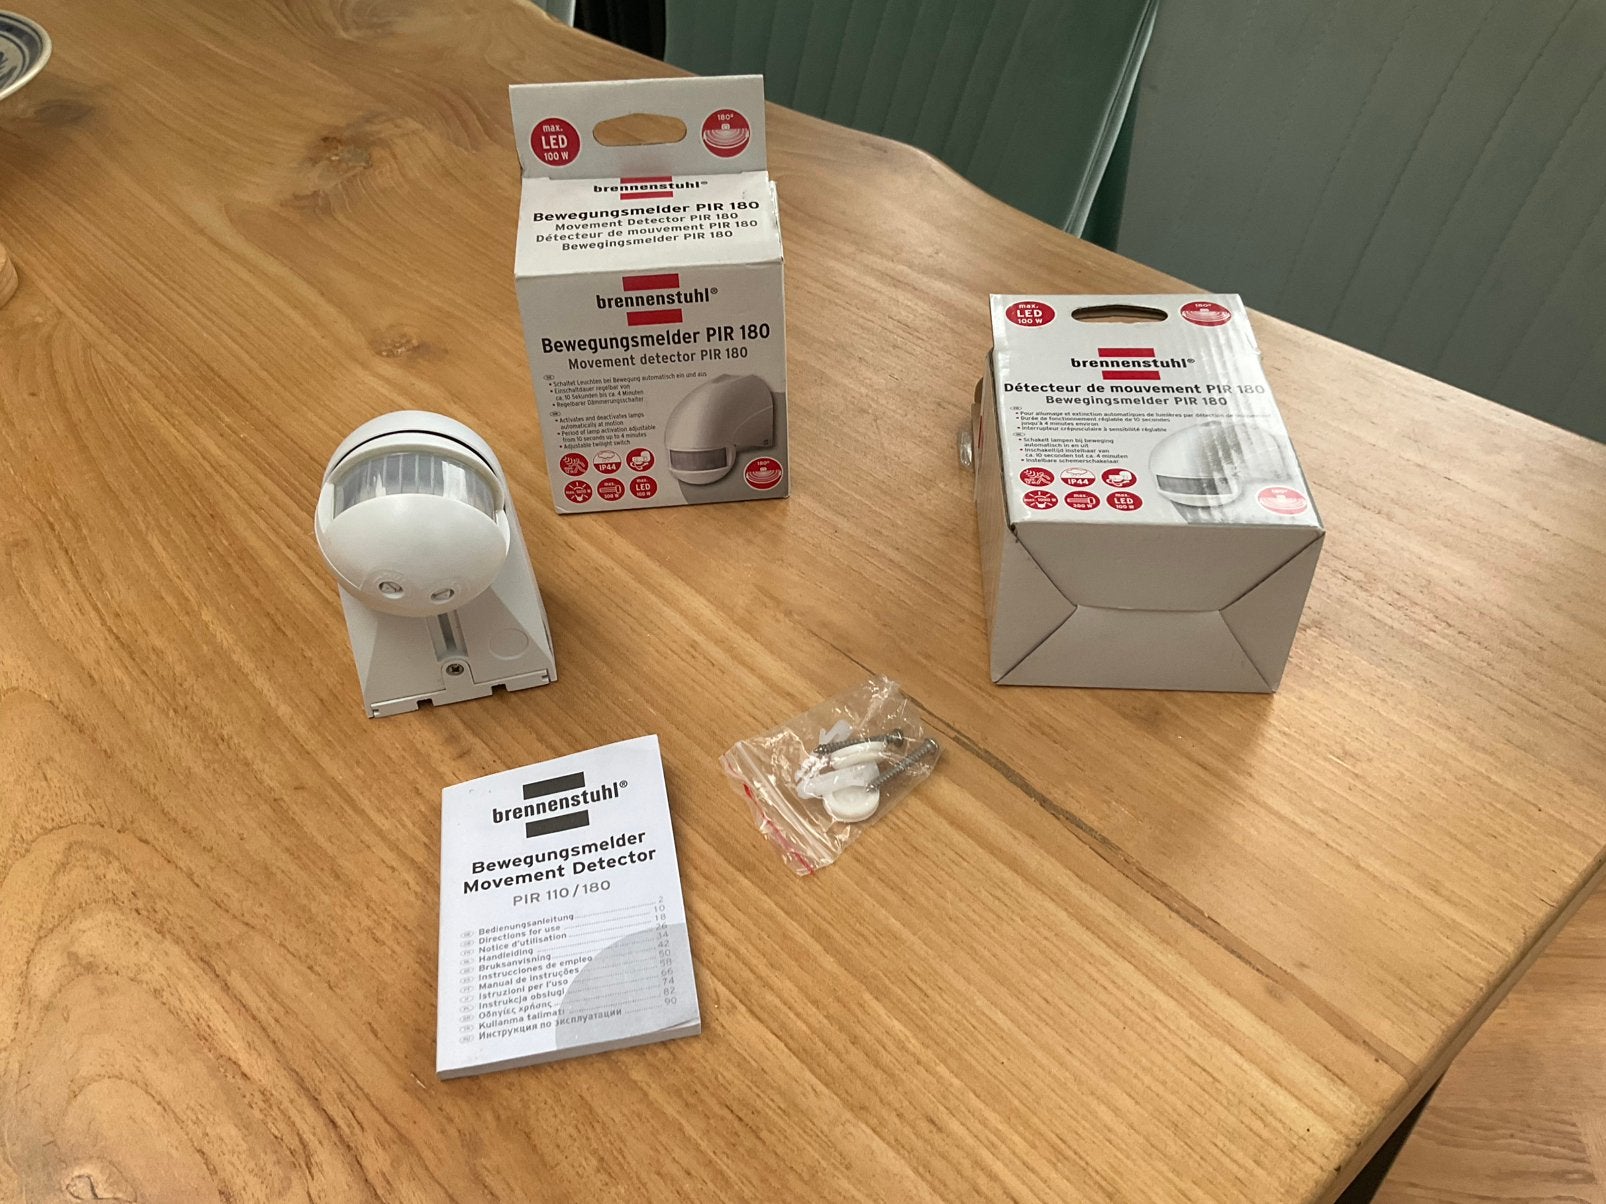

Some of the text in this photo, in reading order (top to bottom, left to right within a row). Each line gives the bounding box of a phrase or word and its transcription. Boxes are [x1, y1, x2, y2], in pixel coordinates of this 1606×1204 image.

[543, 124, 563, 132] max.
[542, 135, 568, 149] LED
[544, 151, 568, 161] 100 W
[533, 201, 759, 222] Bewegungsmelder PIR 180
[555, 219, 623, 231] Movement
[628, 215, 686, 225] Detector
[690, 214, 711, 222] PIR
[536, 231, 603, 243] Détecteur
[608, 228, 623, 237] de
[628, 224, 704, 235] mouvement
[562, 234, 679, 250] Bewegingsmelder
[1017, 309, 1042, 318] LED
[542, 323, 770, 354] Bewegungsmelder PIR 180
[568, 347, 748, 370] Movement detector PIR 180
[1004, 382, 1264, 394] Détecteur de mouvement PIR 180
[1046, 395, 1227, 406] Bewegingsmelder PIR 180
[472, 831, 646, 874] Bewegungsmelder
[463, 848, 656, 894] Movement Detector
[514, 892, 540, 906] PIR
[478, 914, 574, 936] Bedienungsanleitung
[479, 931, 526, 944] Directions
[479, 944, 508, 954] Notice
[479, 948, 534, 963] Handleiding
[479, 954, 552, 972] Bruksanvisning
[479, 966, 543, 980] Instrucciones
[560, 956, 592, 968] empleo
[479, 979, 513, 990] Manual
[529, 967, 579, 982] instruções
[479, 986, 525, 1000] Istruzioni
[528, 983, 543, 992] per
[479, 996, 528, 1010] Instrukcja
[479, 1016, 524, 1029] Kullanma
[479, 1023, 537, 1040] Инструкция
[555, 1009, 622, 1026] эксплуатации
